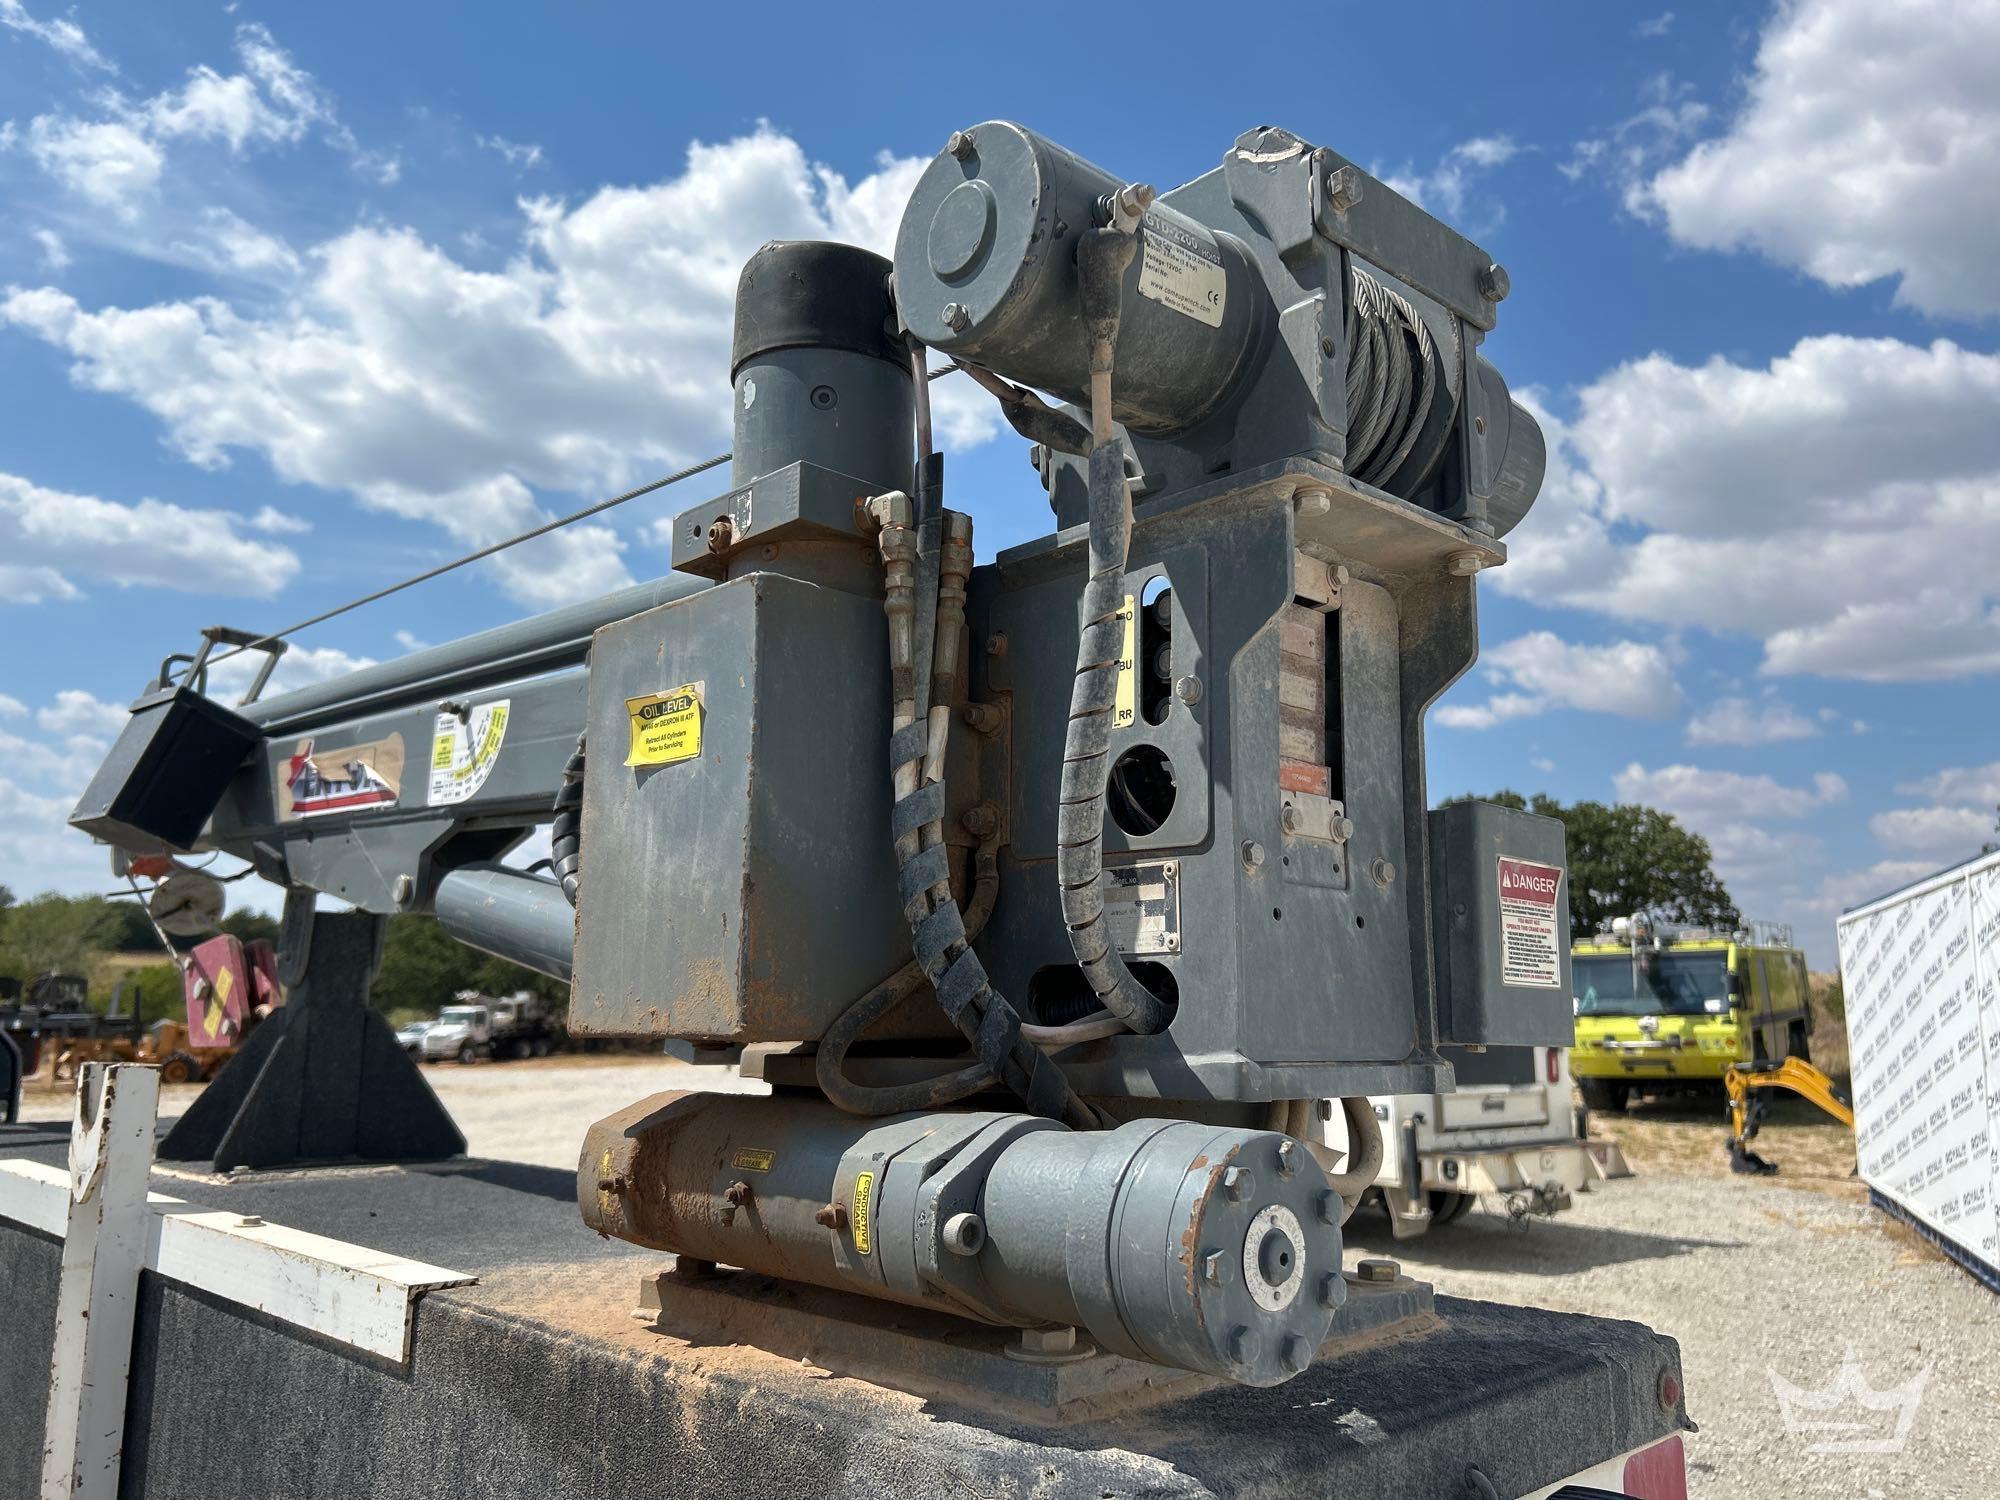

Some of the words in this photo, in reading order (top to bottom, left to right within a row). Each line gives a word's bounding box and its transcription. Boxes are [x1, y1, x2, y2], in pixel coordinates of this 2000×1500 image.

[644, 705, 660, 719] OIL
[662, 697, 690, 714] LEVEL
[1118, 709, 1132, 720] RR
[645, 735, 660, 744] Retract
[666, 729, 687, 741] Cylinders
[648, 744, 658, 753] Prior
[663, 740, 684, 751] Servicing
[1512, 872, 1555, 894] DANGER
[855, 1190, 863, 1232] GREASE
[860, 1179, 870, 1245] CONDUCTIVE
